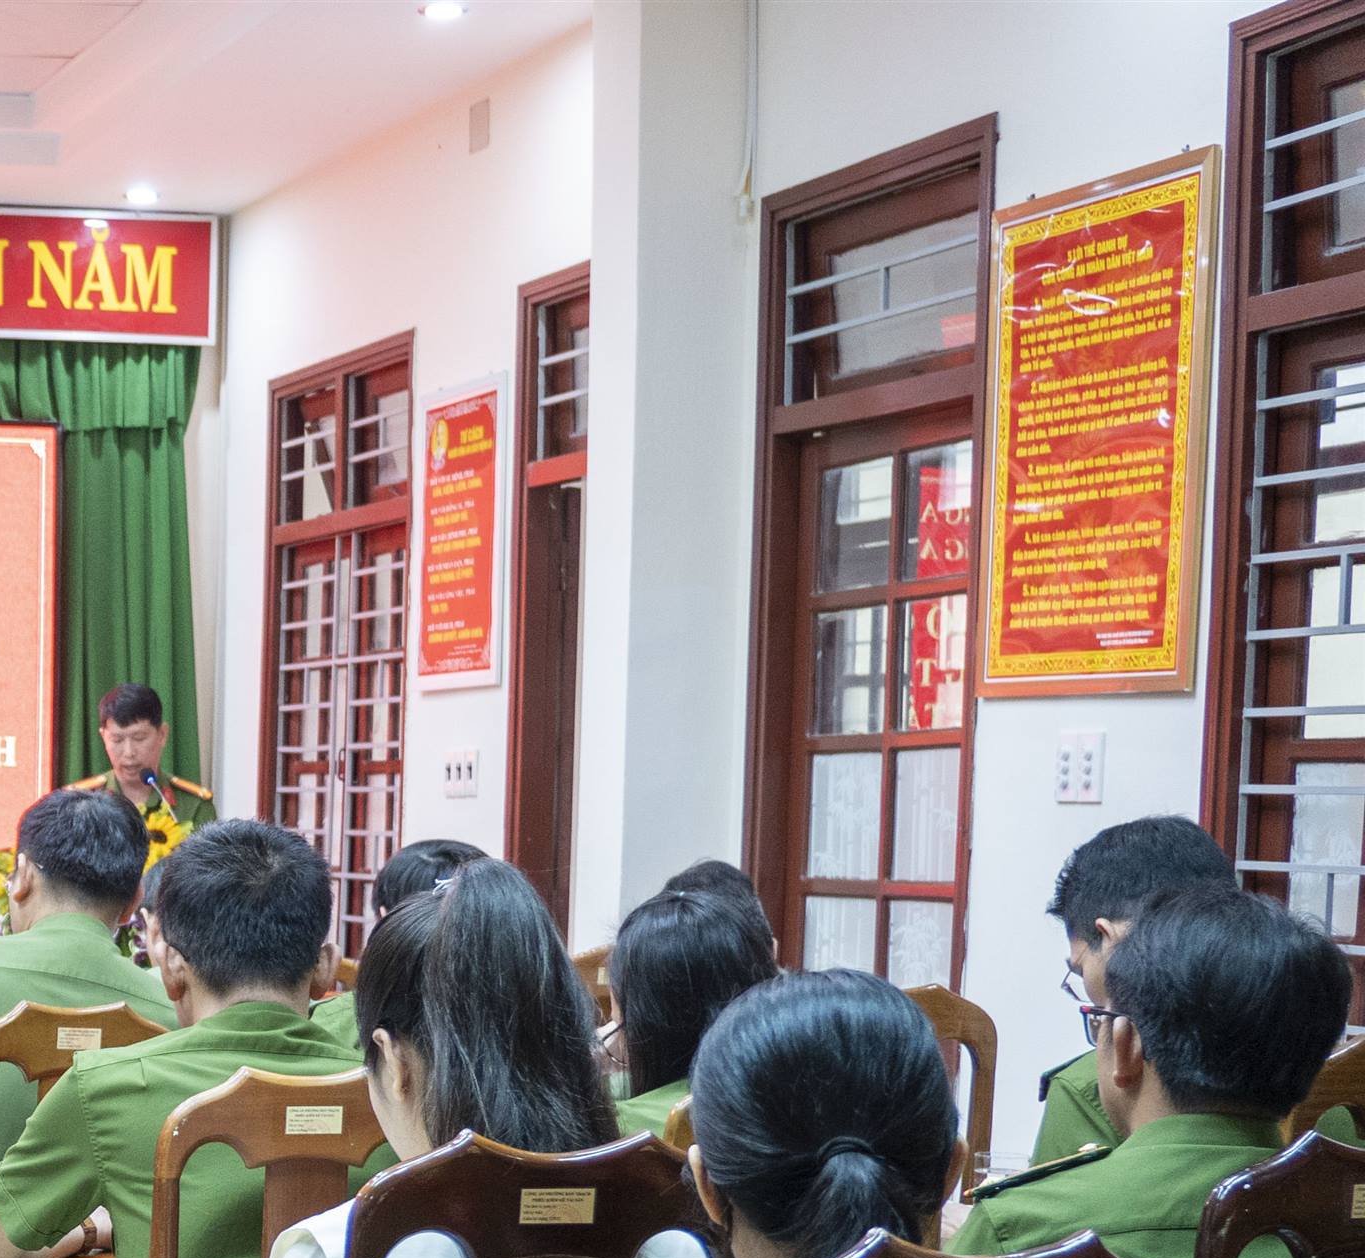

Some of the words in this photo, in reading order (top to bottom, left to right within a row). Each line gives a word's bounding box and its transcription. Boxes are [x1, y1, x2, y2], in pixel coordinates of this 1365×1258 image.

[1067, 248, 1071, 262] 5
[1096, 237, 1116, 255] DANH
[1117, 234, 1127, 252] DỰ
[1075, 263, 1085, 277] AN
[1086, 256, 1105, 274] NHÂN
[1106, 252, 1120, 270] DÂN
[1121, 248, 1135, 268] VIỆT
[27, 226, 177, 315] NĂM
